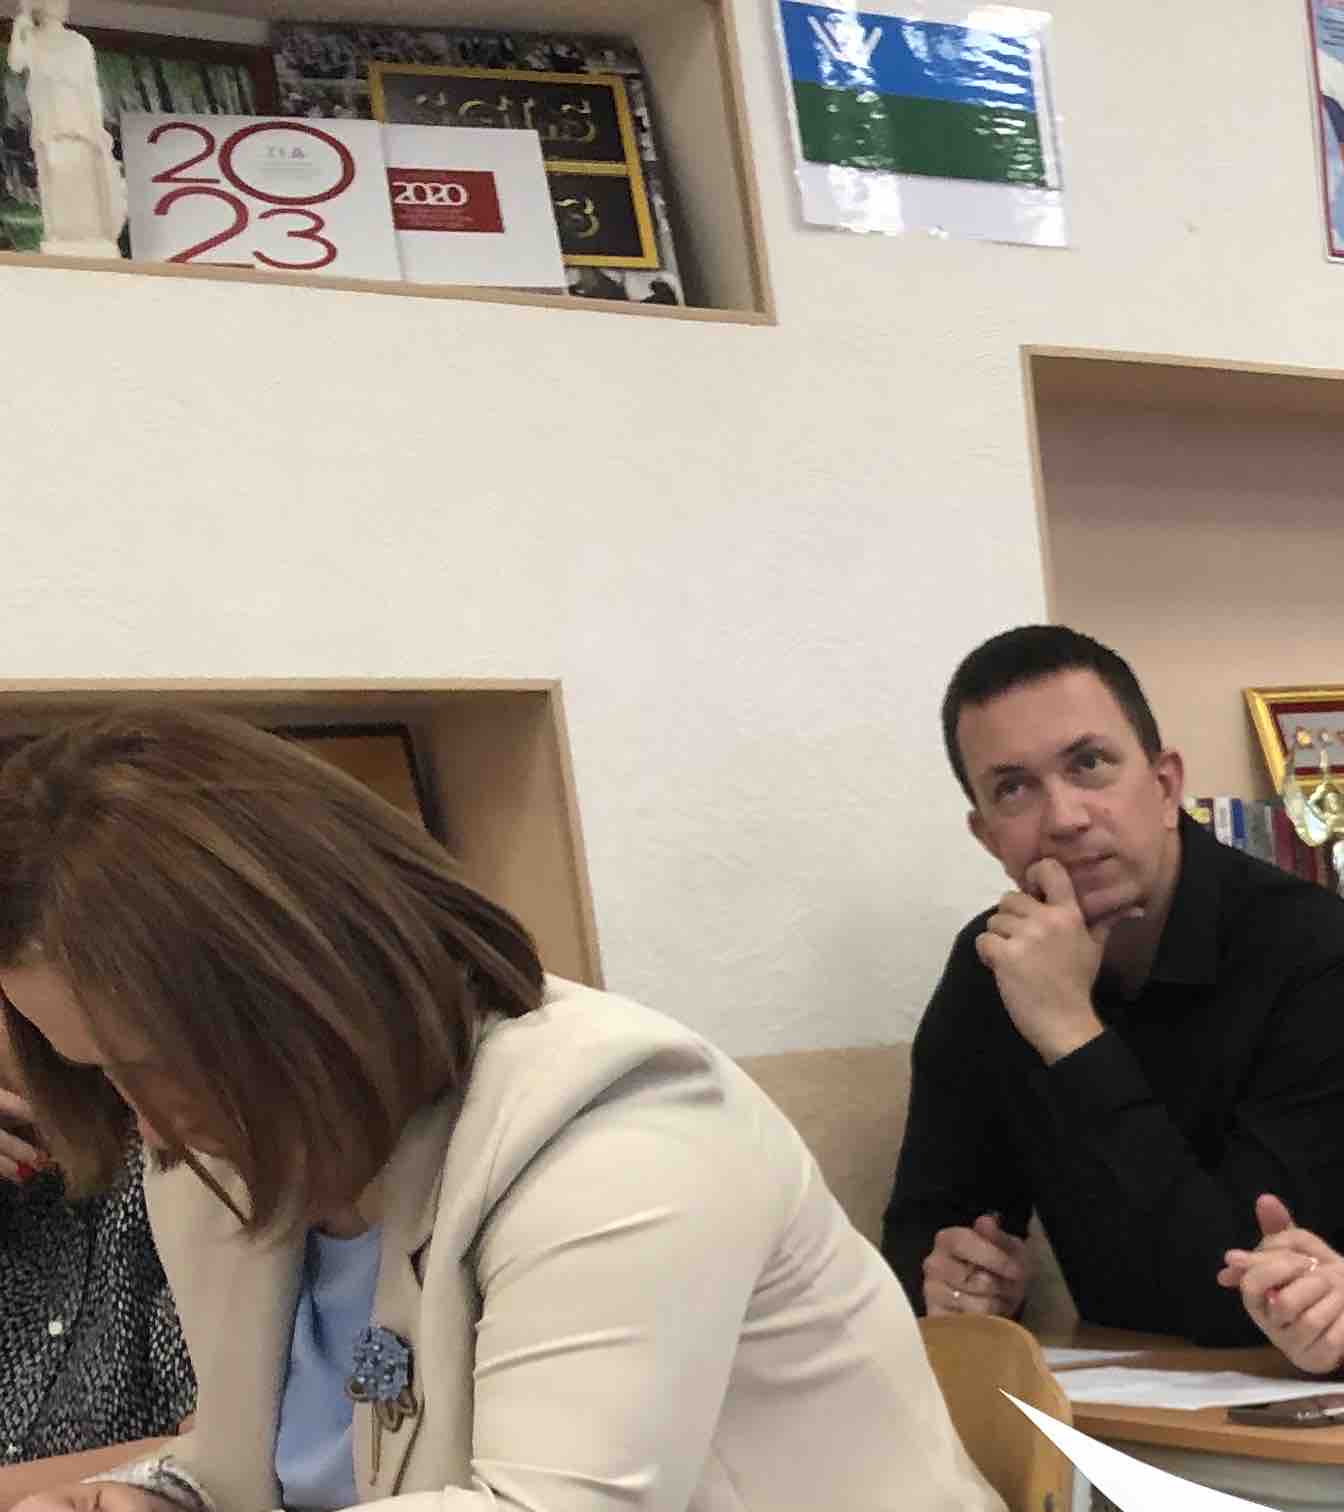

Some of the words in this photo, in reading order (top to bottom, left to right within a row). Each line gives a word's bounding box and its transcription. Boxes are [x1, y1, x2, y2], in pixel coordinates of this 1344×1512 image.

[147, 120, 356, 207] 20
[391, 181, 469, 206] 2020
[153, 186, 339, 270] 23
